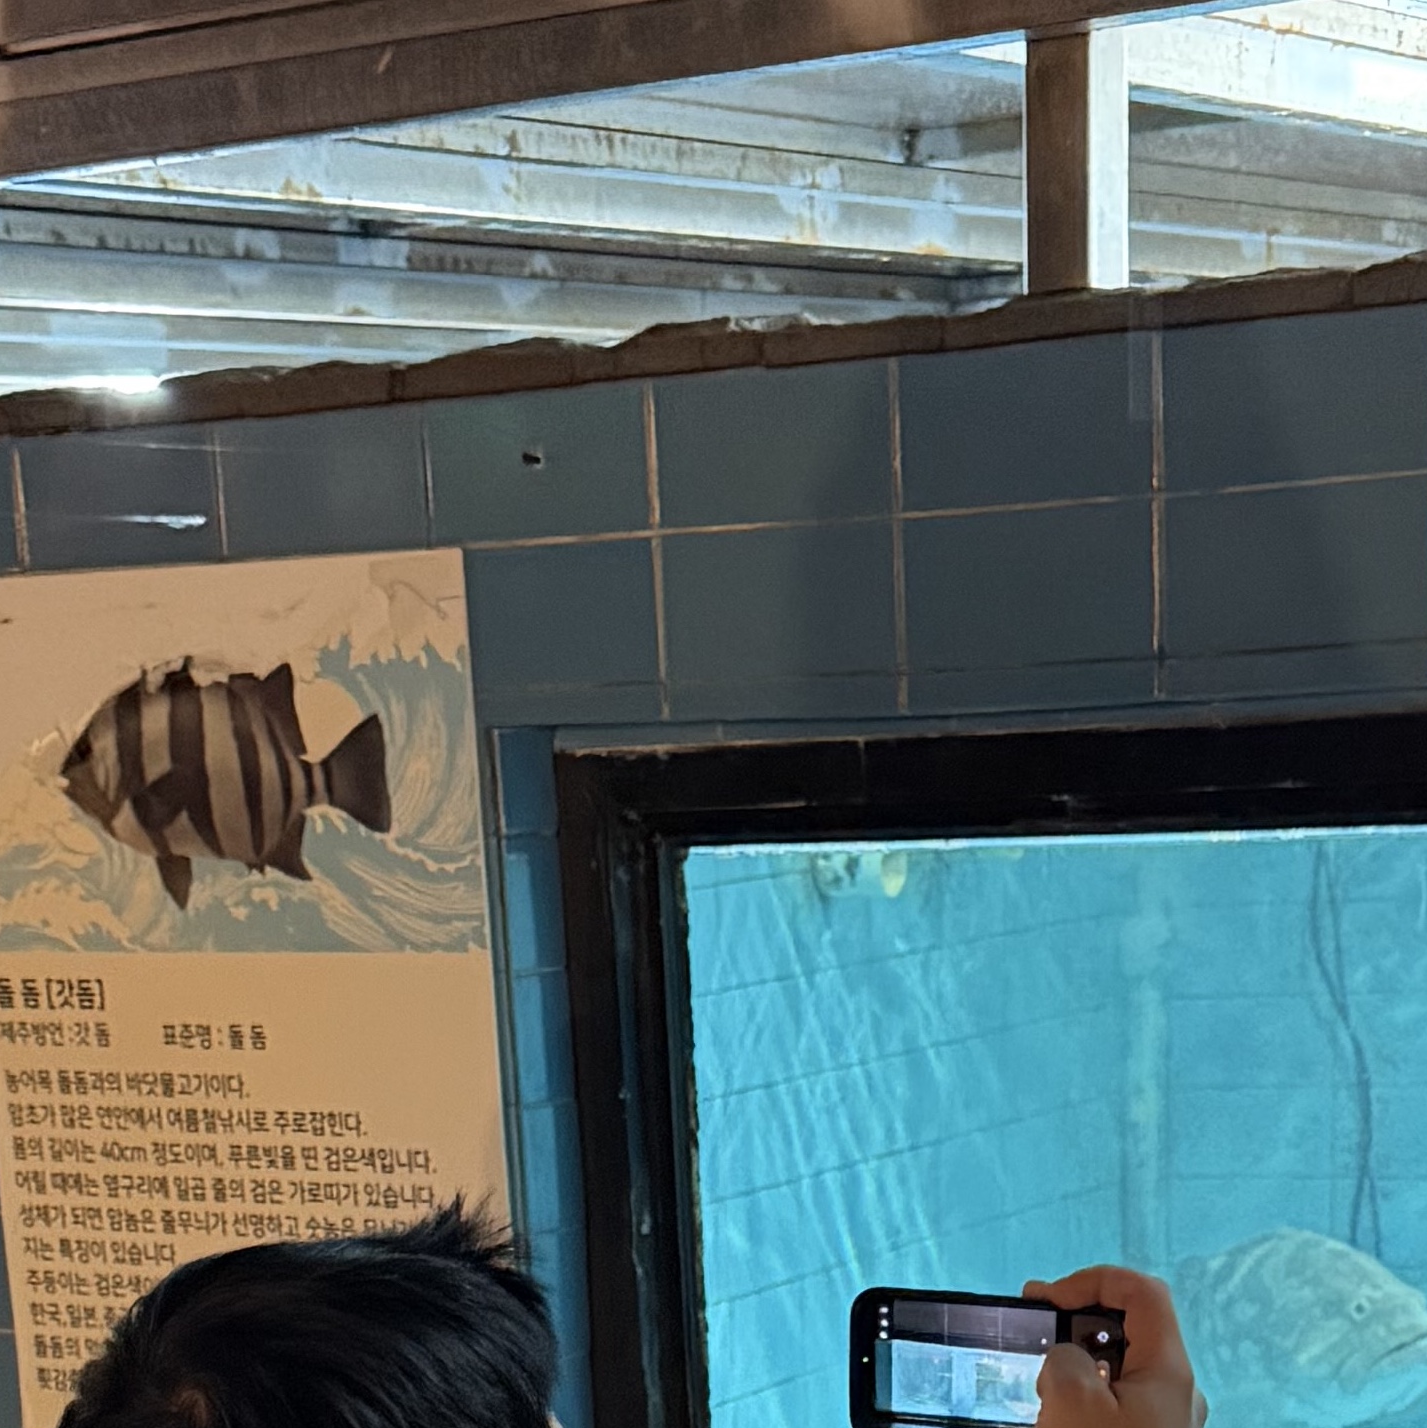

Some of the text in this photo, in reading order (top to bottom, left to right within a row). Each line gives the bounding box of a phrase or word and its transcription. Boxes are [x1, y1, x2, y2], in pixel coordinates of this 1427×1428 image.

[21, 977, 41, 1011] 돔
[44, 977, 107, 1012] [갓돔]
[0, 1020, 65, 1047] 제주방언
[162, 1023, 212, 1050] 표준명
[5, 1069, 251, 1100] 농어목 돌돔과의 바닷물고기이다.
[8, 1103, 56, 1129] 암초가
[96, 1105, 164, 1133] 연안에서
[12, 1135, 45, 1162] 몸의
[47, 1137, 97, 1164] 길이는
[100, 1141, 149, 1164] 40cm
[228, 1145, 297, 1172] 푸른빛을
[15, 1170, 47, 1196] 어릴
[102, 1173, 171, 1200] 옆구리에
[249, 1178, 285, 1205] 검은
[288, 1180, 360, 1208] 가로띠가
[19, 1204, 67, 1230] 성체가
[160, 1209, 229, 1236] 줄무늬가
[232, 1212, 300, 1240] 선명하고
[22, 1237, 55, 1261] 지는
